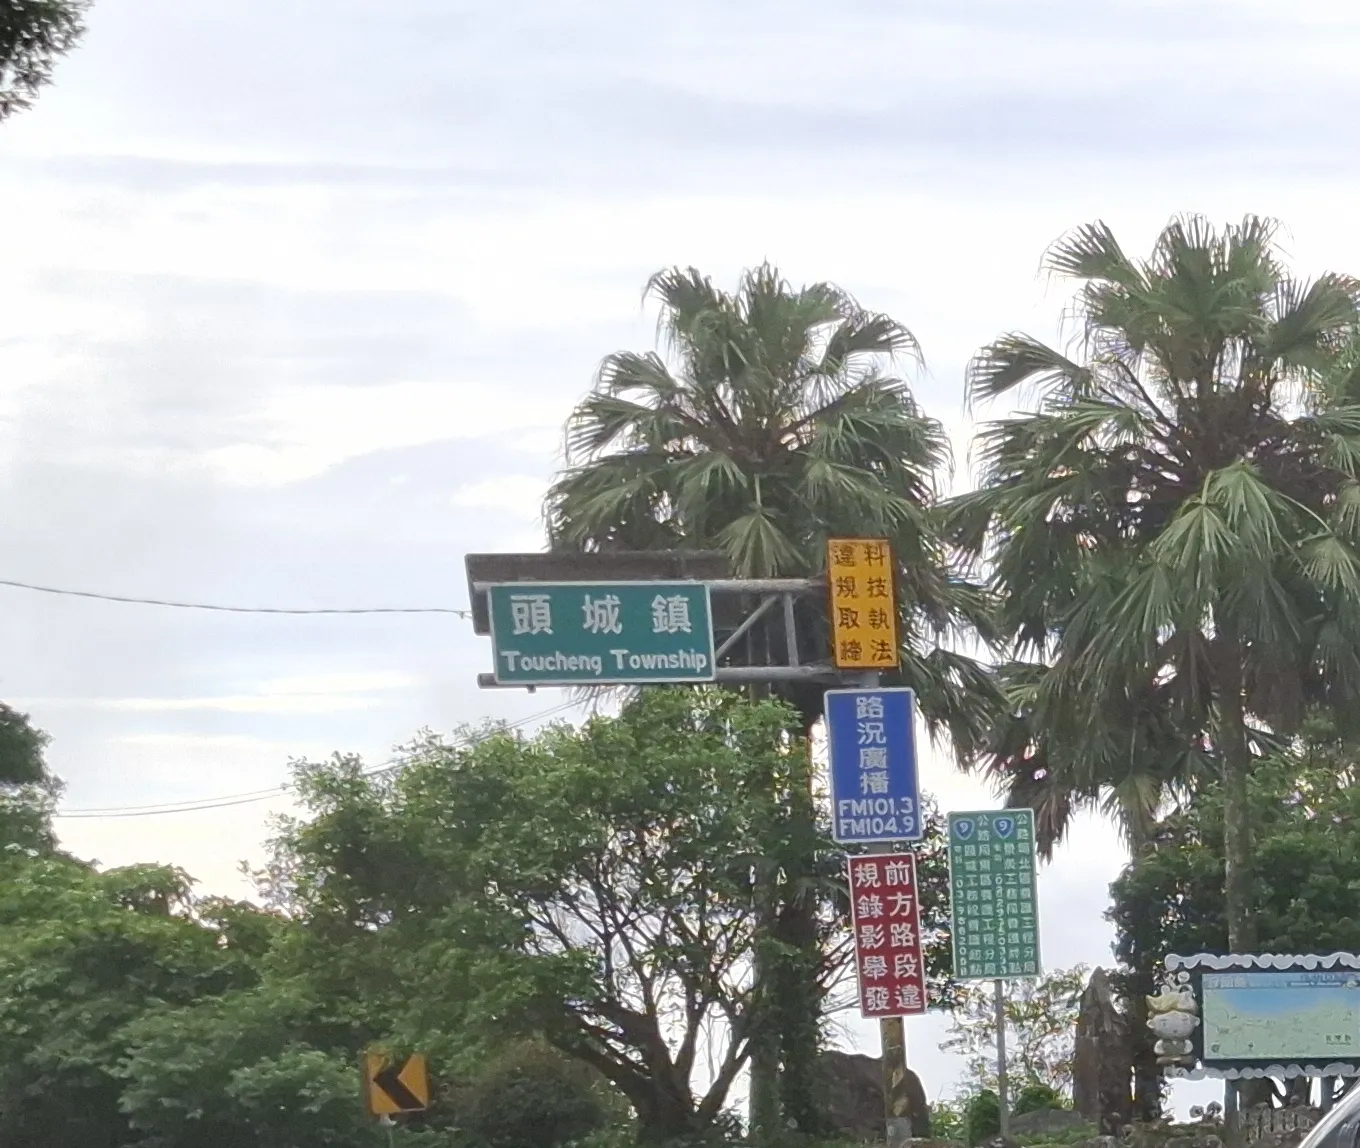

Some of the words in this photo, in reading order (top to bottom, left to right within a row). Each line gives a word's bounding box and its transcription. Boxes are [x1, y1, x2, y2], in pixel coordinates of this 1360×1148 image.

[510, 594, 692, 635] 頭城鎮
[832, 545, 862, 661] 違規取締
[864, 543, 893, 662] 科技執法
[501, 651, 602, 676] Toucheng
[610, 649, 707, 673] Township
[856, 696, 890, 794] 路況廣播
[838, 797, 913, 817] FM101.3
[839, 816, 914, 836] FM104.9
[854, 862, 890, 1011] 規錄影舉發
[884, 860, 922, 1010] 前方路段違
